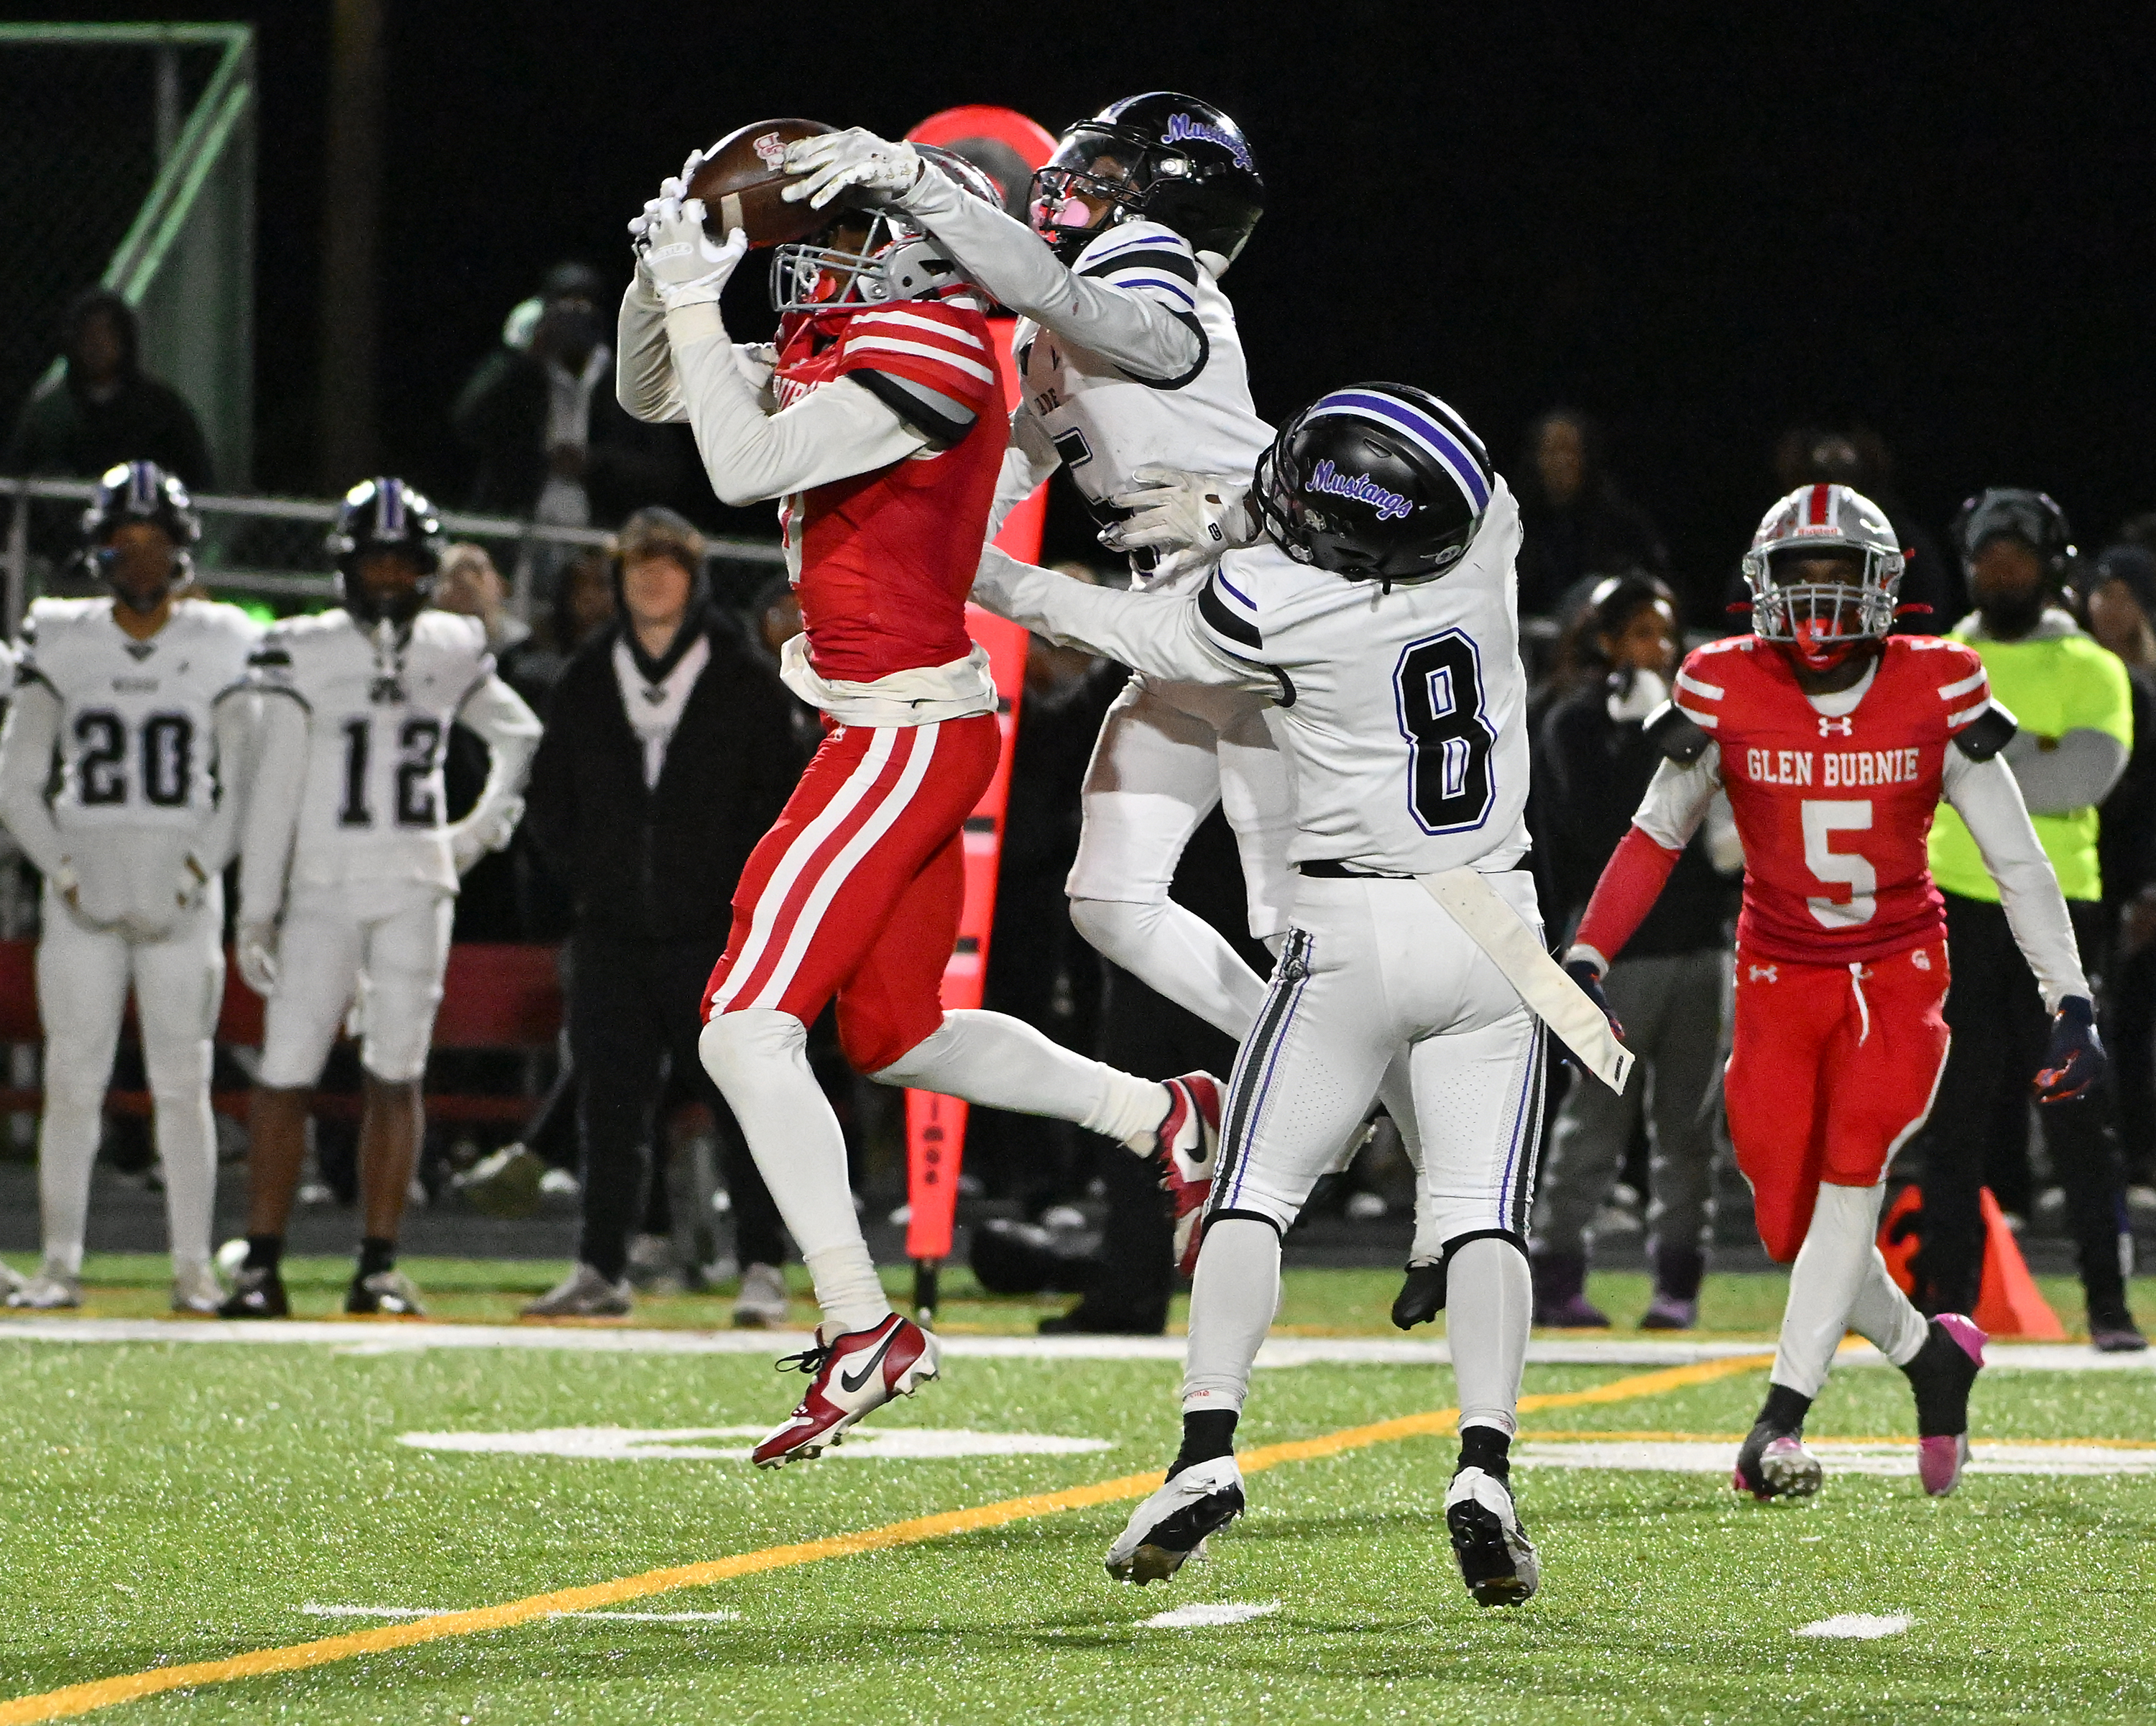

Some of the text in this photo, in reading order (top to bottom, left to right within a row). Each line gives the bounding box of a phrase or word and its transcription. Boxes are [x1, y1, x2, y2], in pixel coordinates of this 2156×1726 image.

[1305, 459, 1413, 520] Mustangs
[73, 709, 193, 807] 20
[336, 717, 443, 830] 12
[1392, 627, 1498, 836] 8
[1747, 748, 1920, 787] GLEN BURNIE
[1801, 799, 1877, 929] 5
